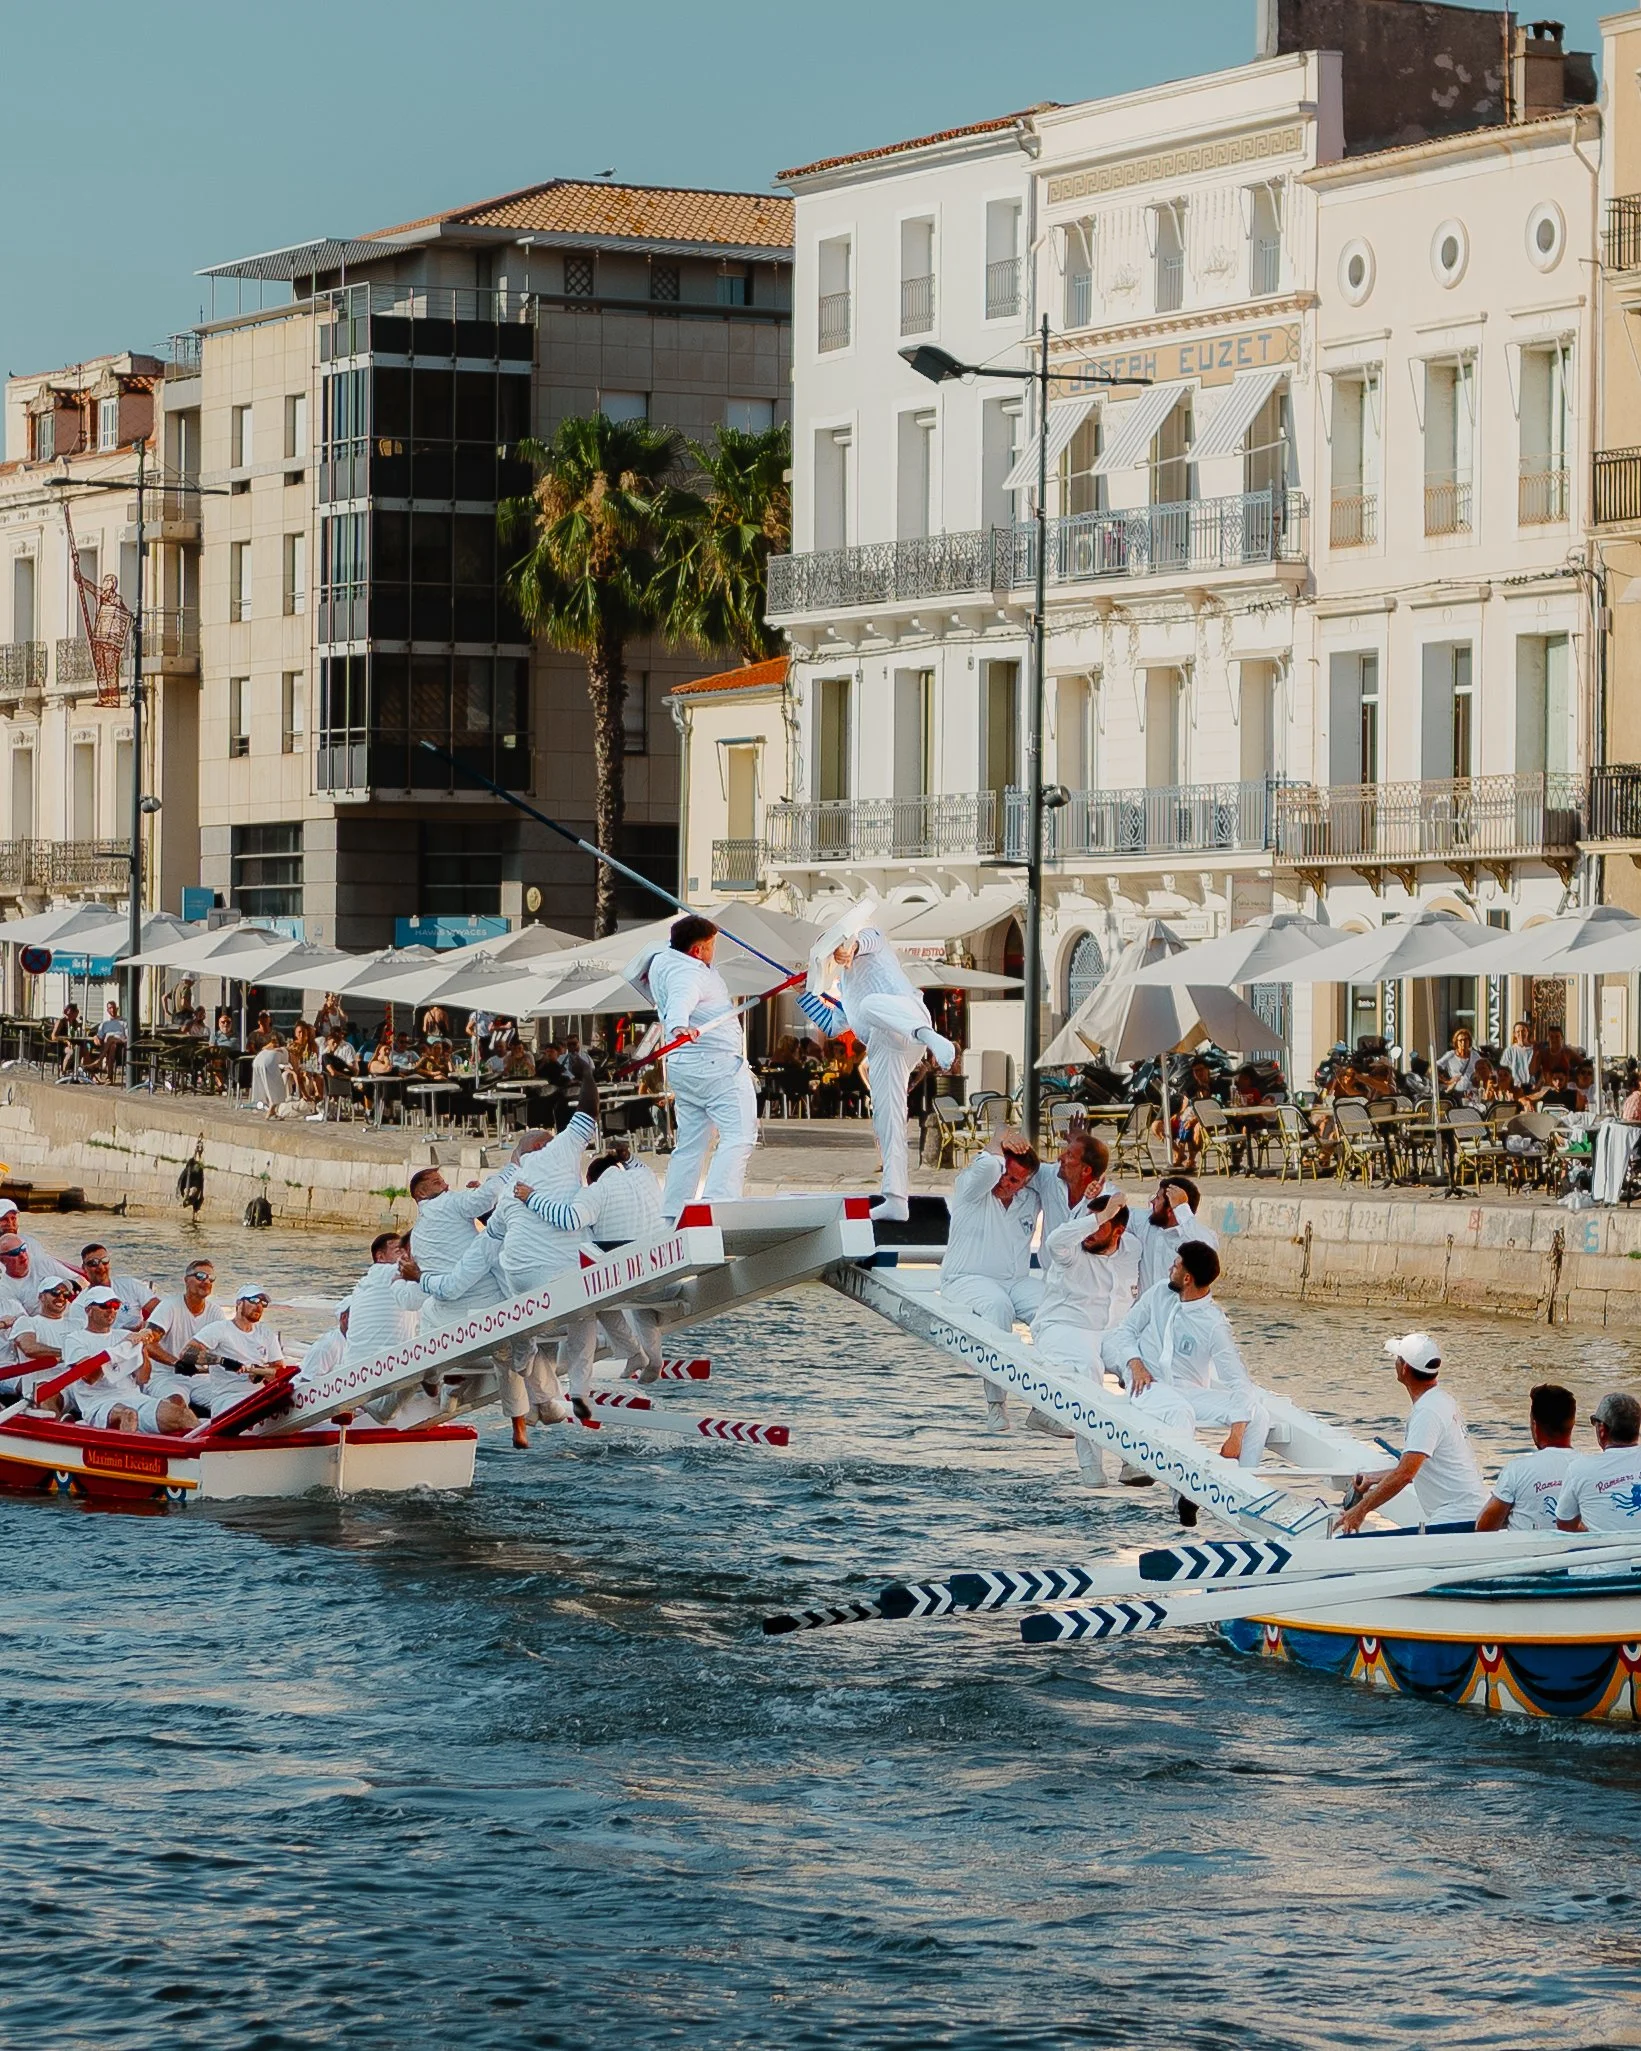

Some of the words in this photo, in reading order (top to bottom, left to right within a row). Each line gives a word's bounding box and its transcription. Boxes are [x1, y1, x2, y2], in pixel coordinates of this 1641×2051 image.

[1070, 352, 1157, 391] JOSEPH
[1180, 334, 1272, 374] EUZET
[1385, 979, 1396, 1050] ABORA
[1489, 974, 1500, 1048] NALYS
[583, 1262, 622, 1297] VILLE
[626, 1253, 645, 1281] DE
[88, 1449, 123, 1468] Maximin
[125, 1454, 161, 1473] Licciardi
